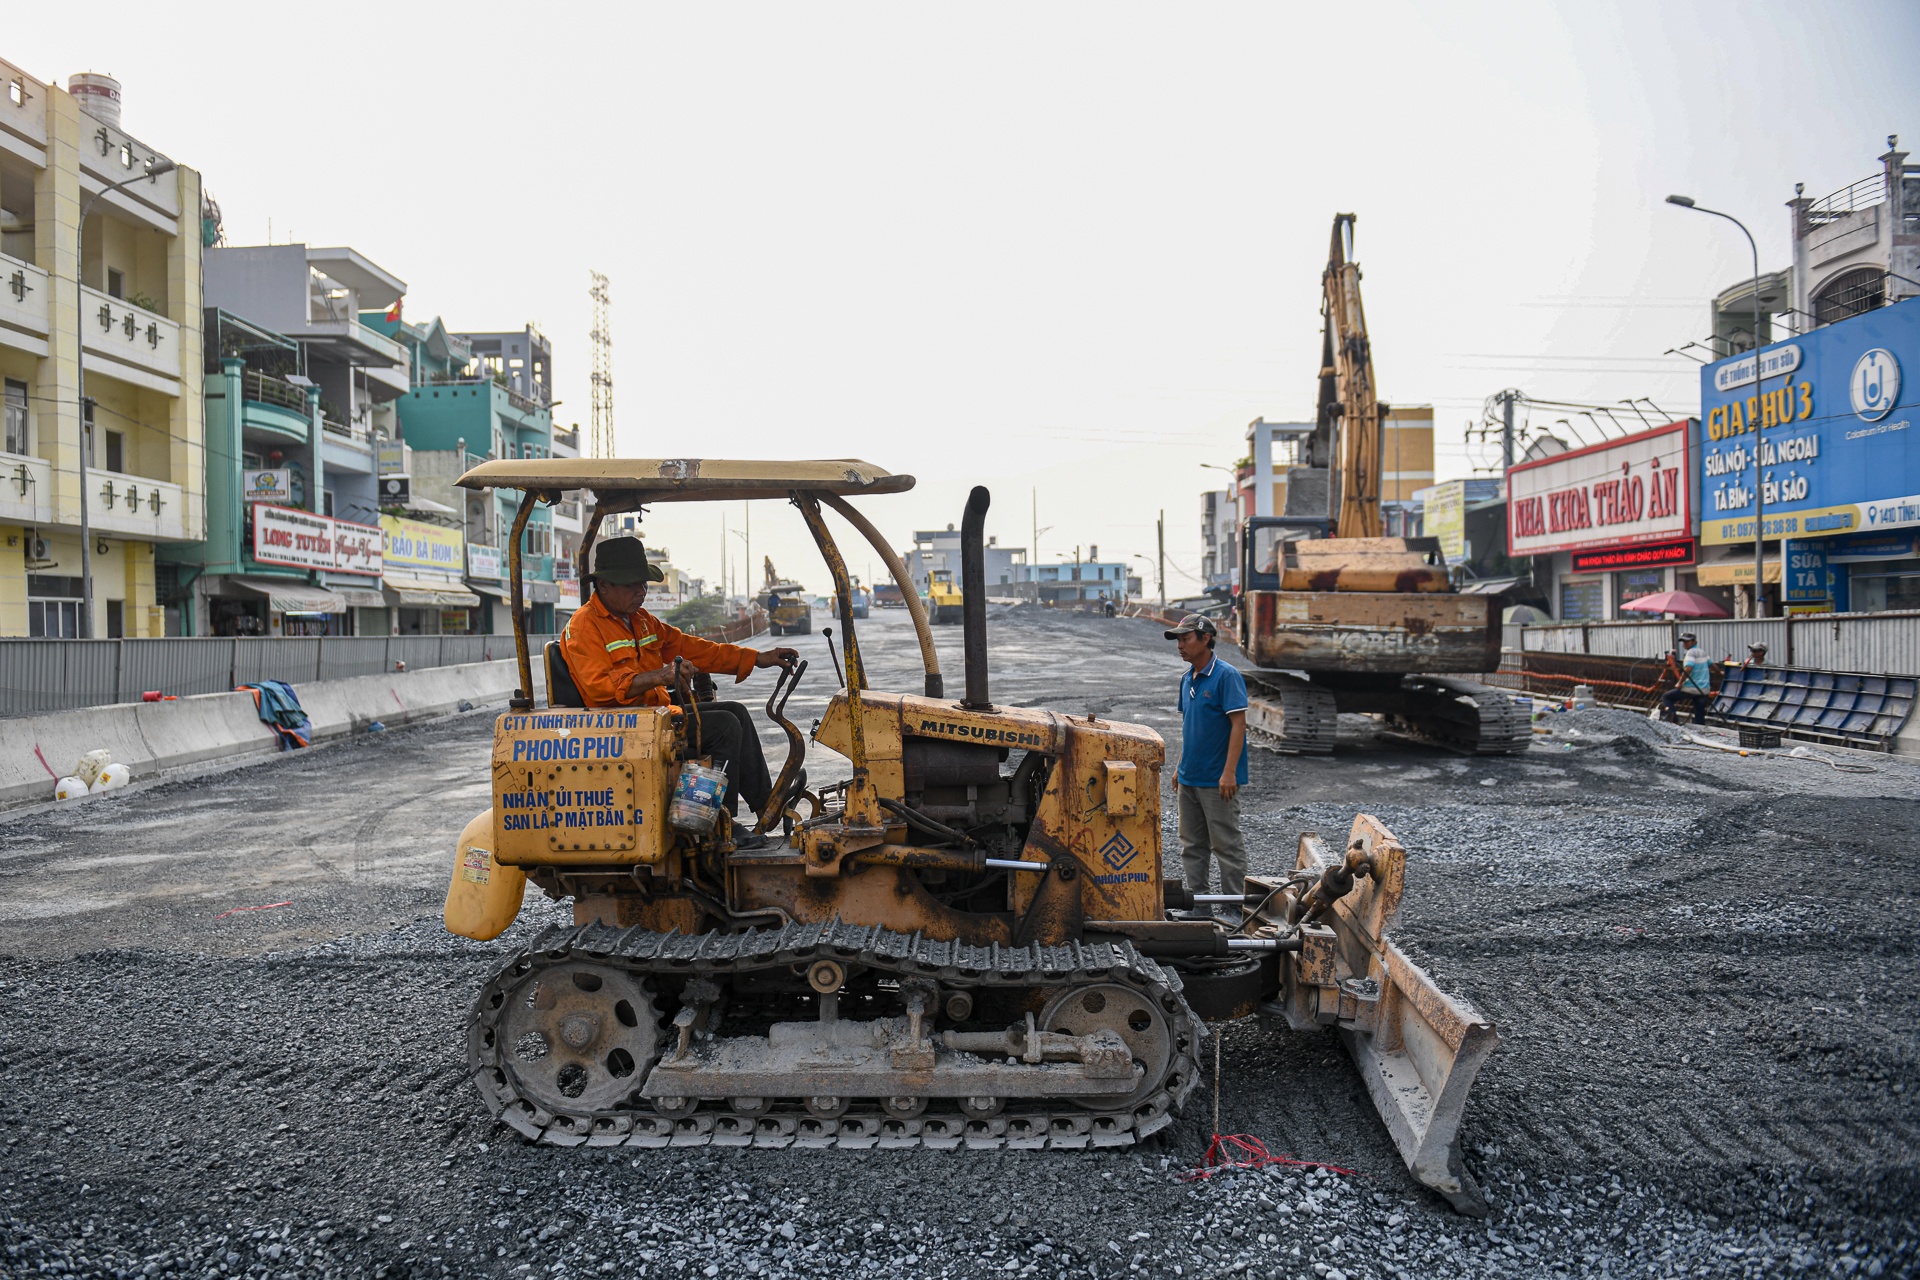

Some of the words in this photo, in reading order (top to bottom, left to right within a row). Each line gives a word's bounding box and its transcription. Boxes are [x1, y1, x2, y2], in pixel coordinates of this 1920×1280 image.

[1708, 401, 1744, 441] GIA
[1747, 375, 1794, 433] PHÚ
[1798, 381, 1813, 419] 3
[1726, 443, 1746, 478] NỘI
[1778, 434, 1819, 466] NGOẠI
[1514, 496, 1546, 538] NHA
[1547, 486, 1592, 533] KHOA
[1593, 461, 1643, 526] THẢO
[1647, 457, 1679, 519] ÂN
[1782, 470, 1808, 502] SÀO
[263, 527, 293, 548] LONG
[416, 536, 429, 560] BÀ
[432, 542, 452, 563] HOM
[1791, 552, 1822, 569] SỮA
[1796, 570, 1818, 587] TÃ
[503, 714, 528, 731] CTY
[531, 714, 563, 730] TNHH
[565, 713, 594, 729] MTV
[595, 713, 615, 729] XD
[617, 713, 638, 728] TM
[921, 720, 1041, 746] MITSUBISHI
[513, 737, 581, 762] PHONG
[503, 788, 549, 811] NHẬN
[556, 785, 571, 807] ỦI
[575, 787, 614, 807] THUÊ
[503, 814, 530, 831] SAN
[565, 807, 594, 831] MẶT
[1094, 873, 1127, 885] PHONG
